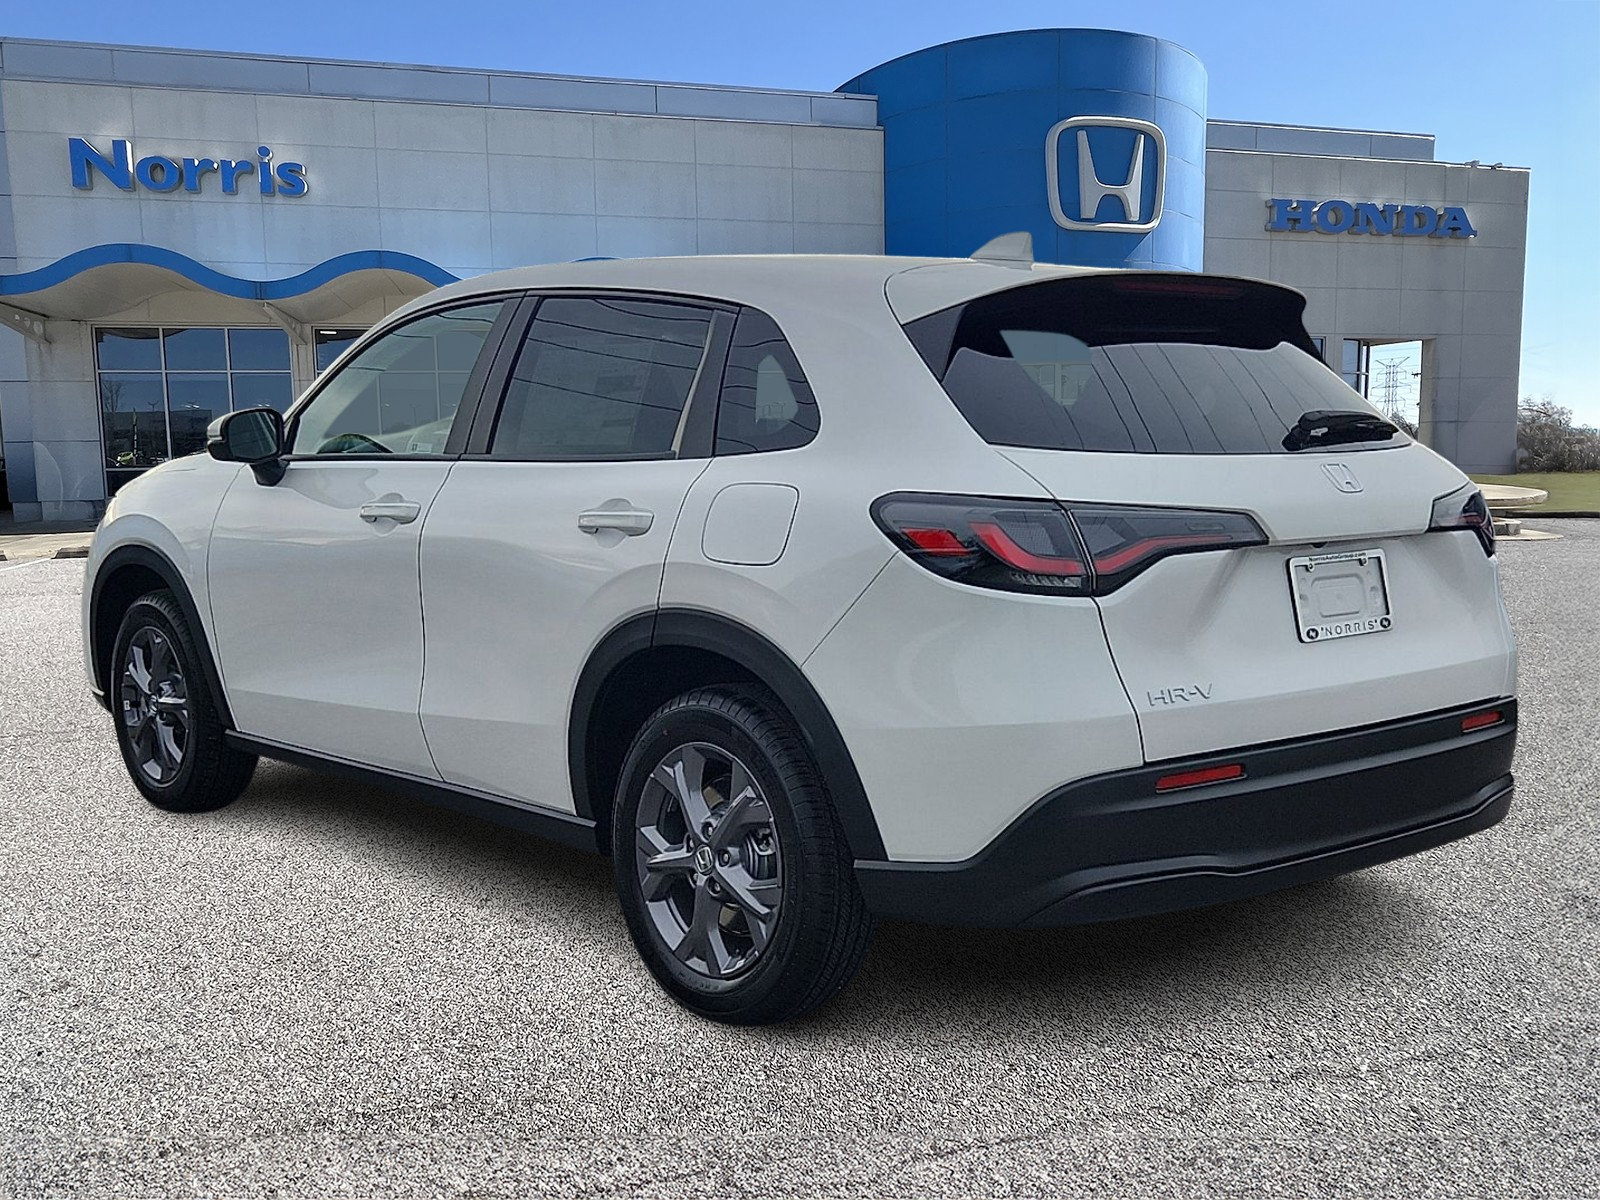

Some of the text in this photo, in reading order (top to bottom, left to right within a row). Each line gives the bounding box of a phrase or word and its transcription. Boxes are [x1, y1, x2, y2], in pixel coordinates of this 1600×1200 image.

[68, 137, 309, 197] Norris
[1265, 198, 1478, 239] HONDA
[1146, 682, 1213, 706] HR-V
